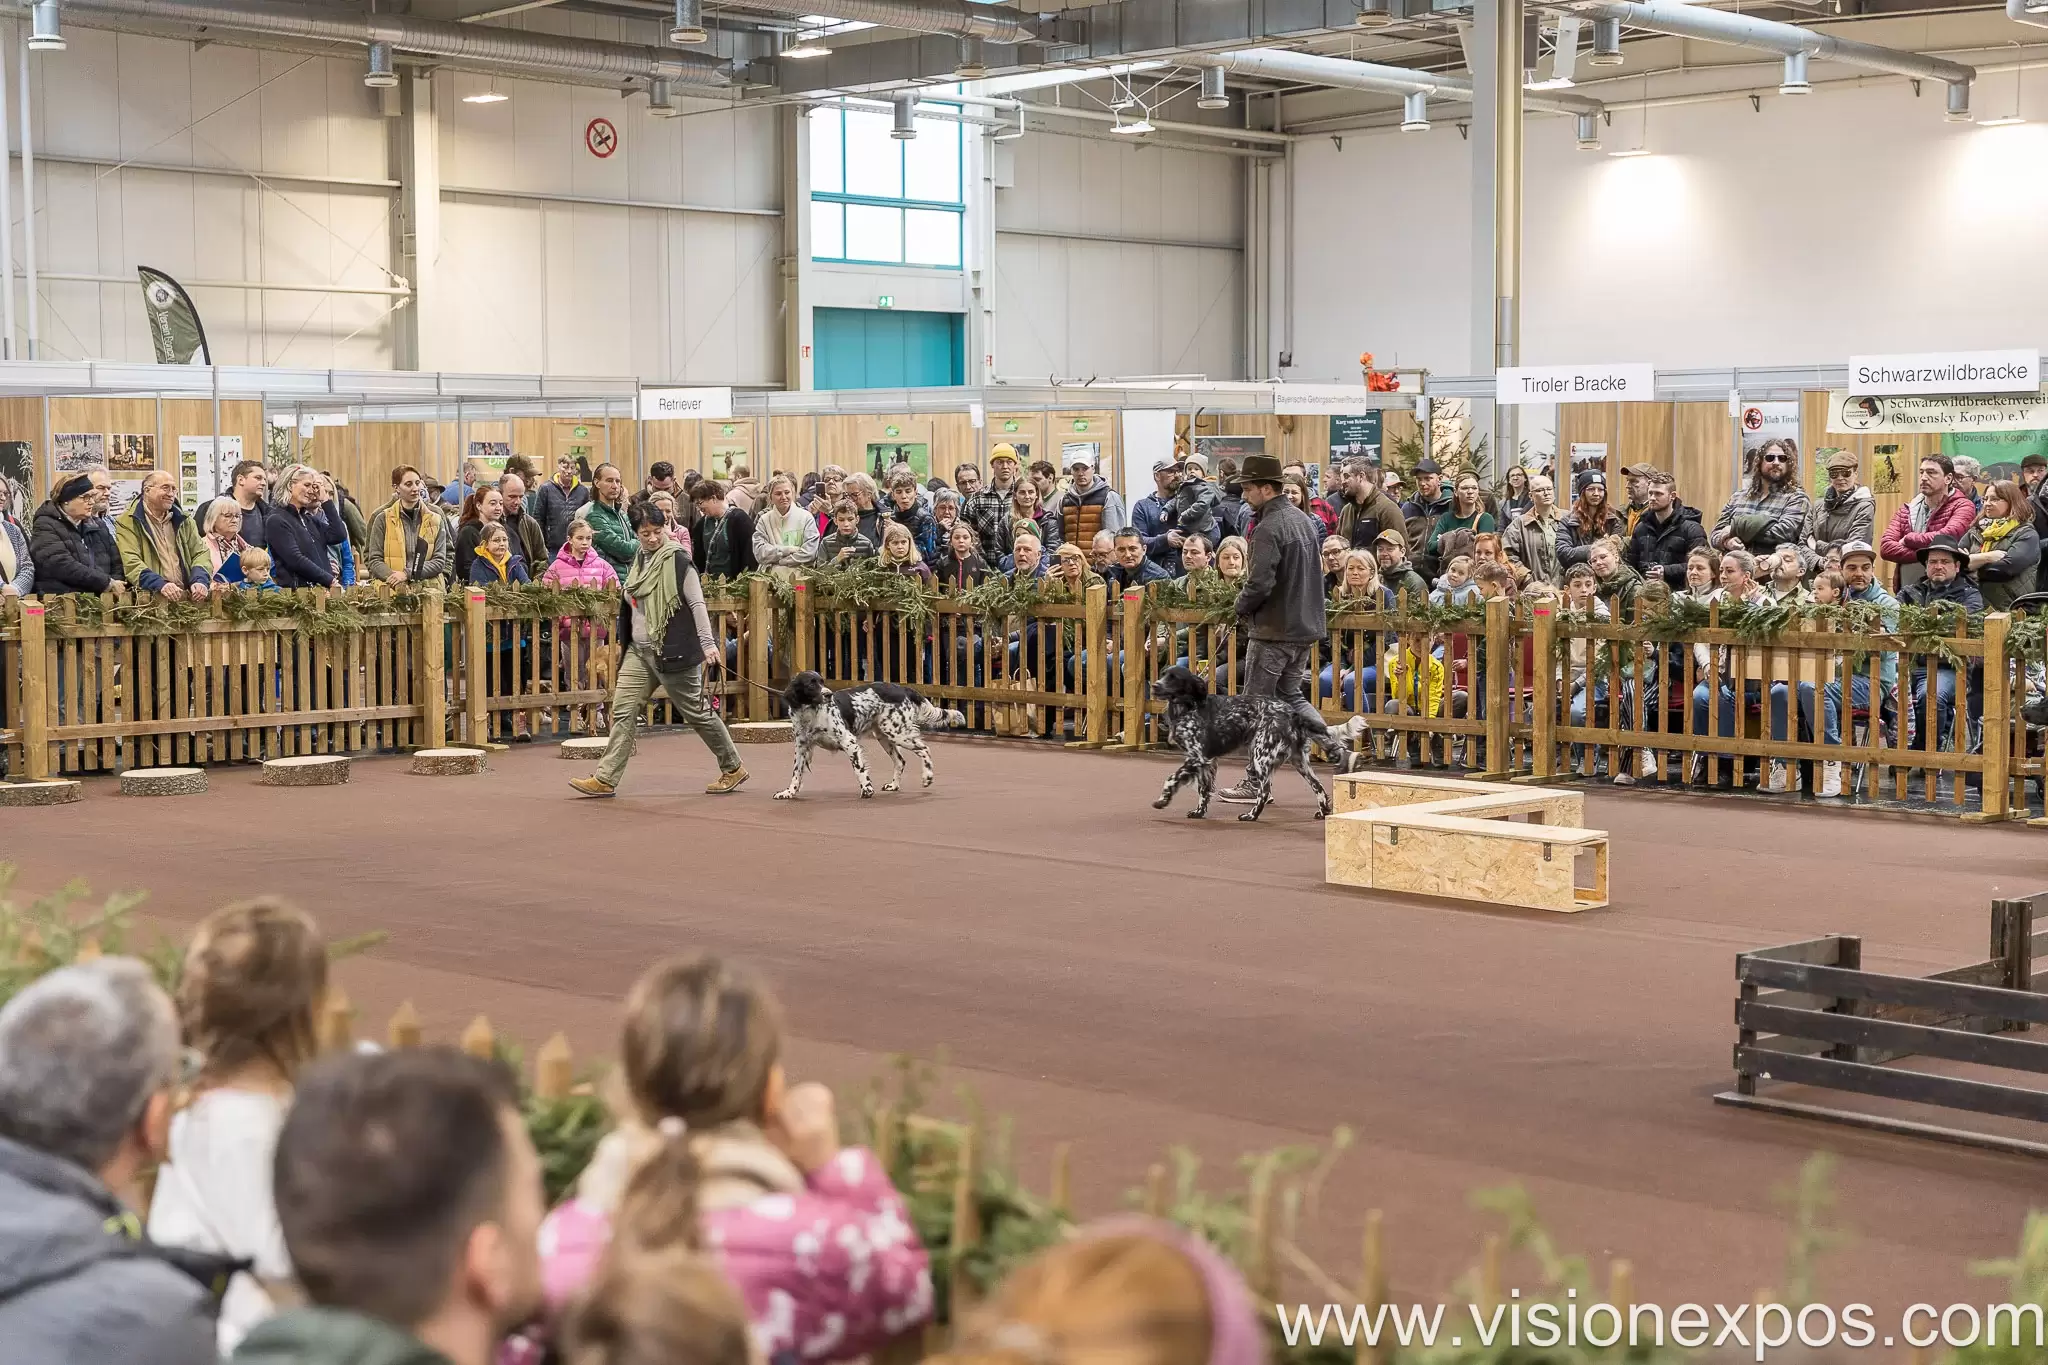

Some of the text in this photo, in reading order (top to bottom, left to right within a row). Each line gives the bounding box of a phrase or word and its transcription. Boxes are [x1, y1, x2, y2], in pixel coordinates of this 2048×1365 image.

[159, 310, 171, 336] Verein
[1858, 363, 2028, 384] Schwarzwildbracke
[1521, 375, 1627, 396] Tiroler Bracke
[659, 397, 702, 411] Retriever
[1277, 394, 1306, 405] Bayerische
[1764, 415, 1780, 425] Klub
[1891, 412, 1956, 425] (Slovensky
[1959, 410, 2005, 426] Kopov)
[1952, 431, 2002, 445] (Slovensky
[2004, 432, 2037, 446] Kopov)
